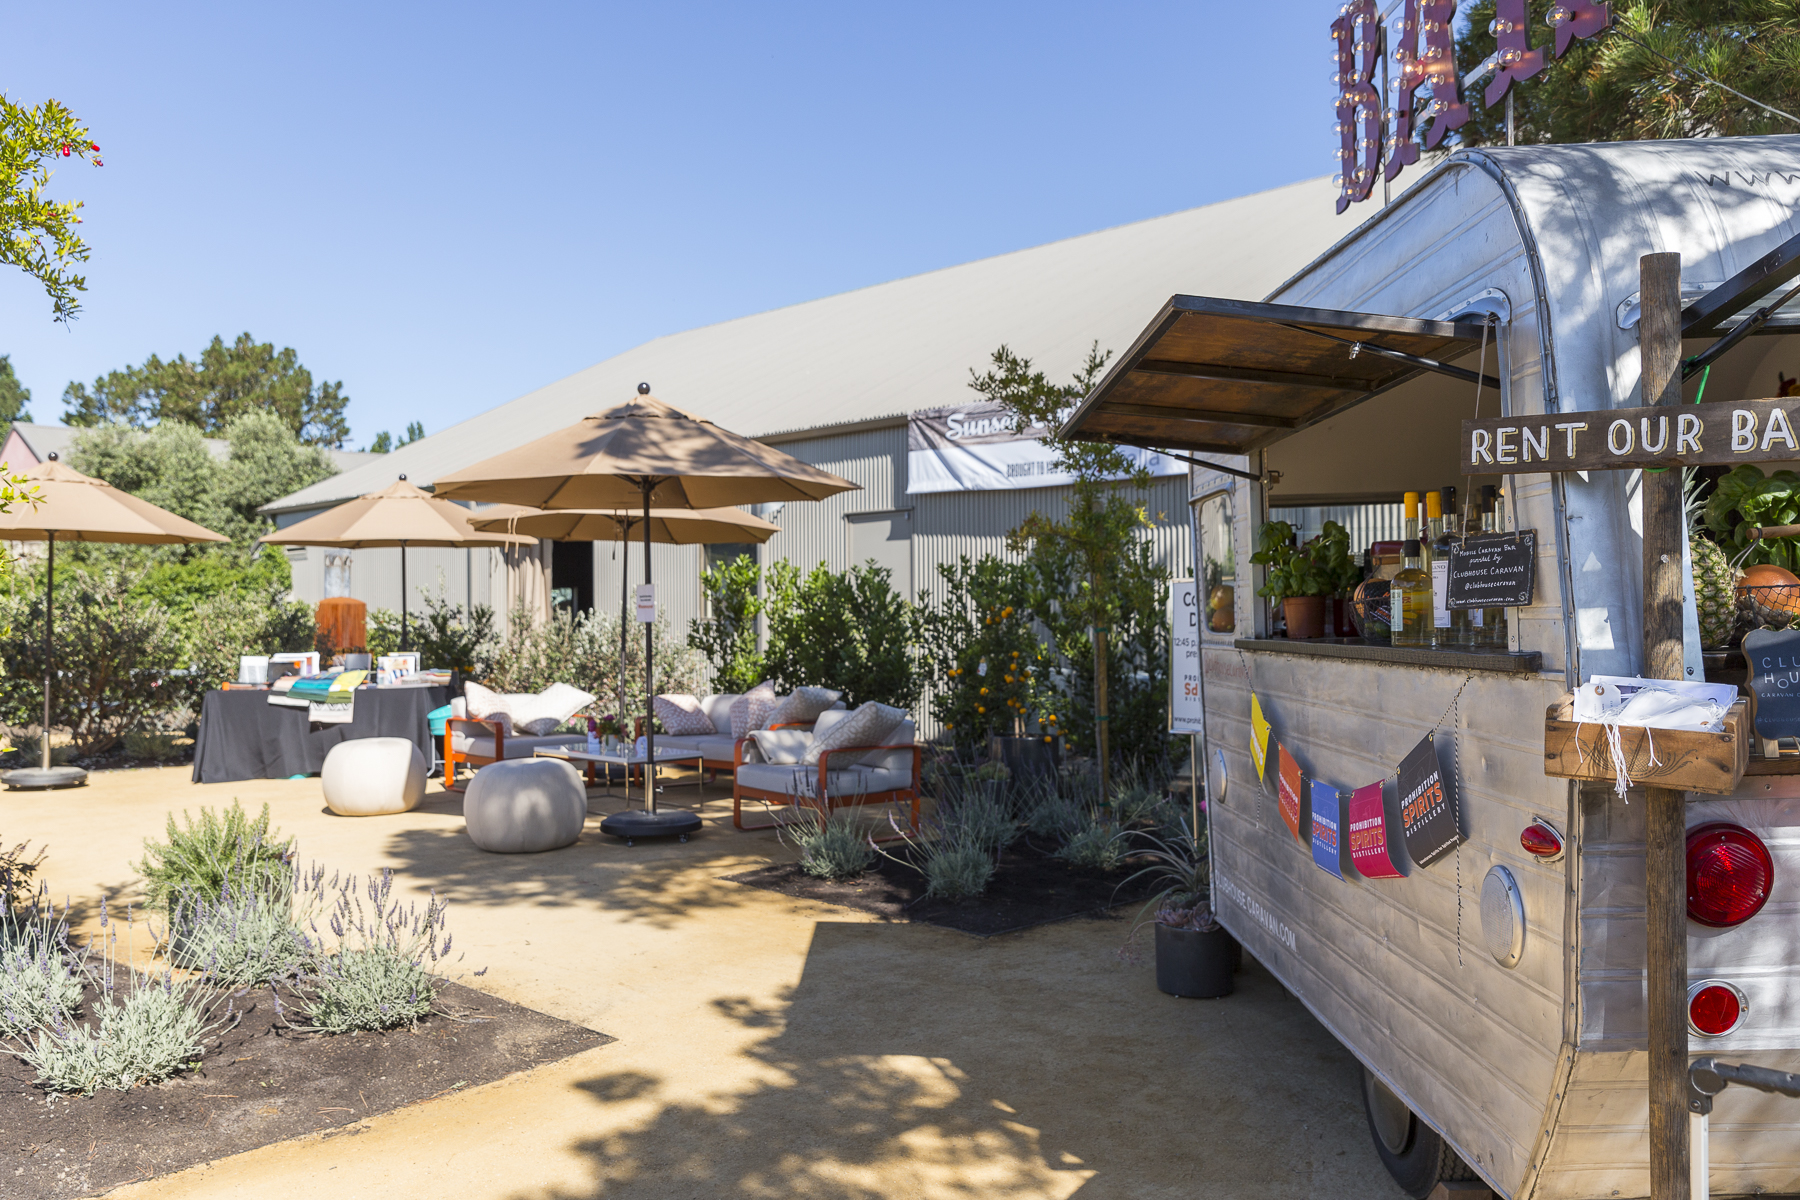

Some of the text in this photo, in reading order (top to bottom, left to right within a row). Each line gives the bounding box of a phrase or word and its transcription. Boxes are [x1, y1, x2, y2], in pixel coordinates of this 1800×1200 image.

[1471, 422, 1588, 465] RENT
[1608, 414, 1703, 456] OUR
[1007, 462, 1035, 478] BROUGHT
[1037, 461, 1045, 476] TO
[1490, 565, 1524, 575] CARAVAN
[1401, 770, 1439, 809] PROHIBITION
[1403, 781, 1443, 828] SPIRITS
[1312, 812, 1337, 831] PROHIBITION
[1350, 816, 1382, 832] PROHIBITION
[1406, 803, 1446, 837] DISTILLERY
[1312, 820, 1337, 847] SPIRITS
[1350, 826, 1384, 851] SPIRITS
[1312, 837, 1337, 855] DISTILLERY
[1352, 847, 1385, 858] DISTILLERY
